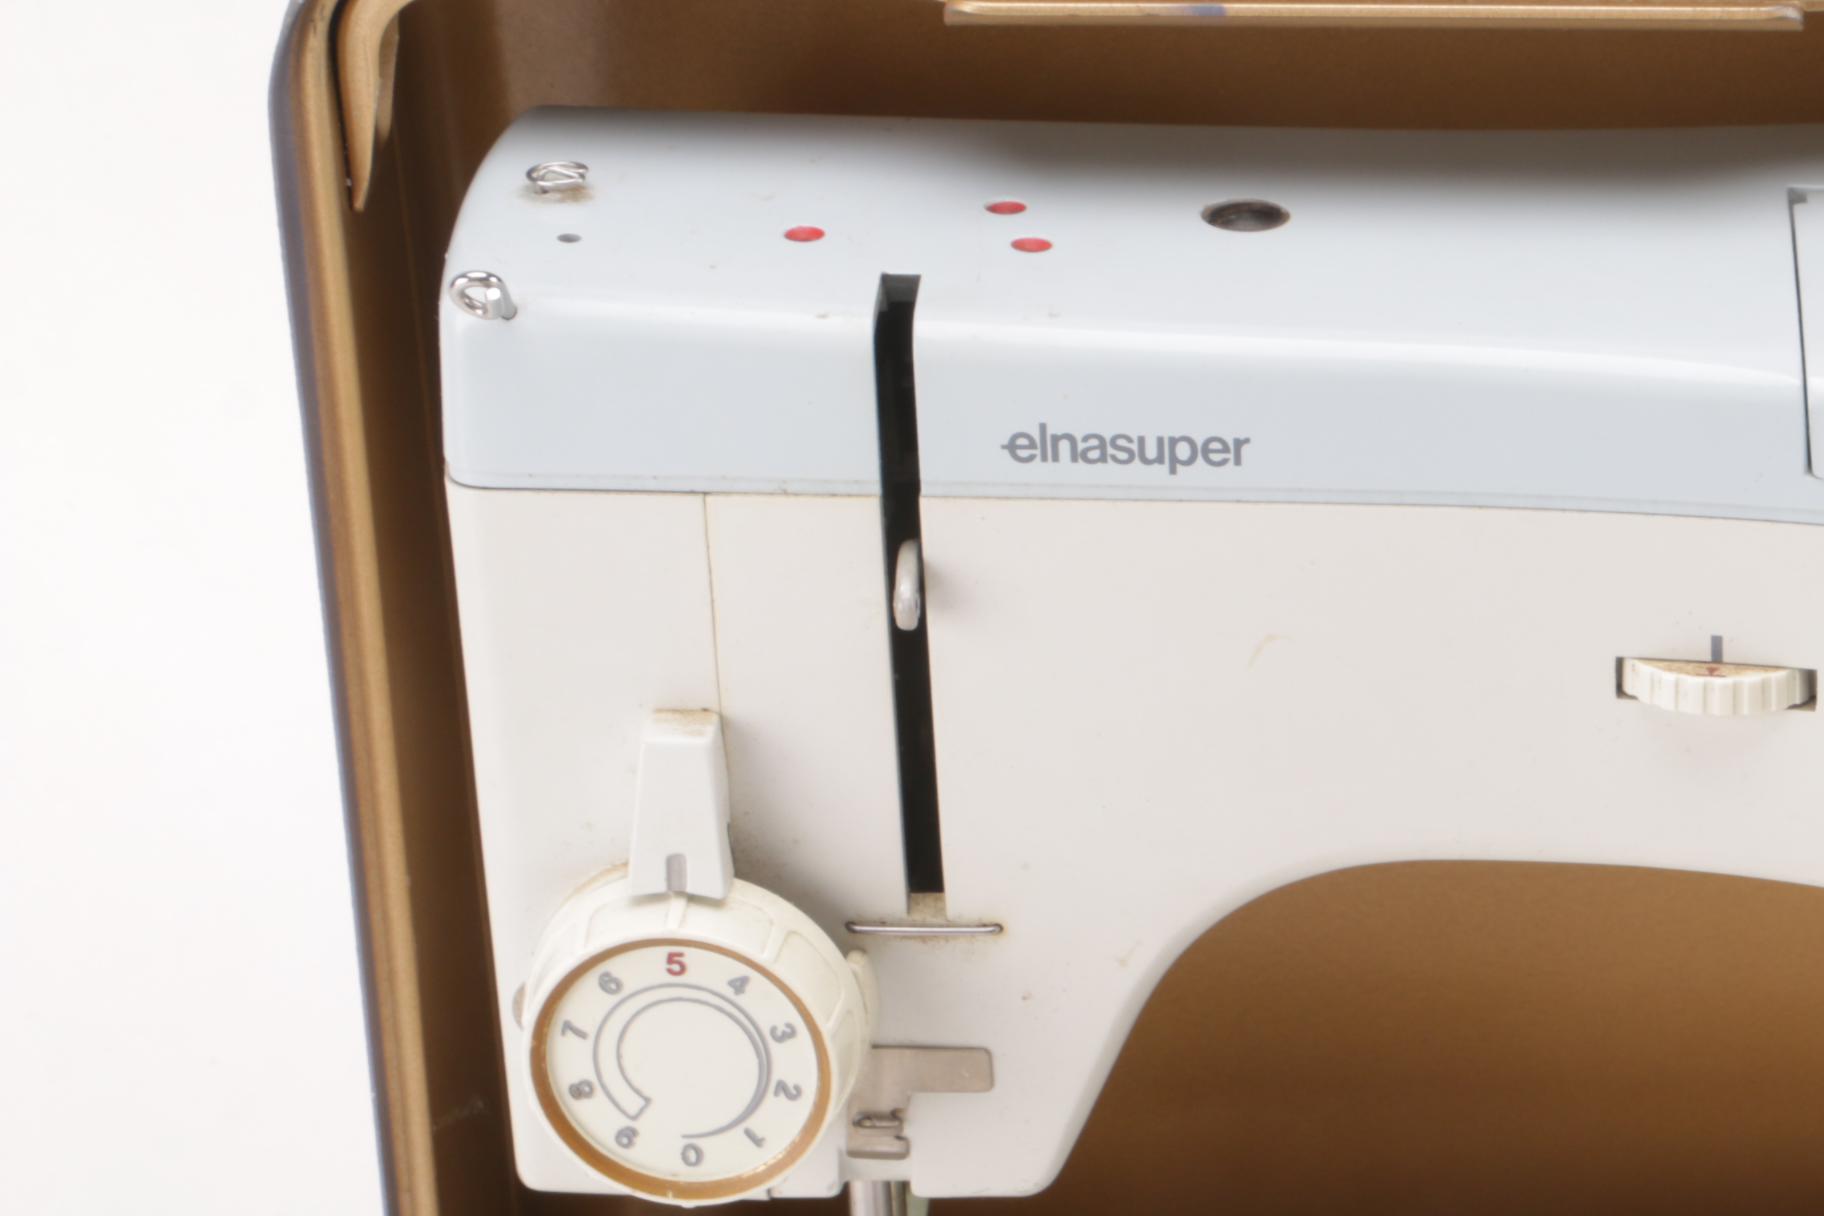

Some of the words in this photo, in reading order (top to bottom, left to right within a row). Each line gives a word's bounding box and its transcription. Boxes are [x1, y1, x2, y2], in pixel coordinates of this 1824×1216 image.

[1000, 422, 1251, 476] elnasuper
[666, 952, 687, 976] 5
[598, 971, 623, 995] 6
[728, 976, 750, 995] 4
[561, 1020, 588, 1040] 7
[770, 1023, 797, 1043] 3
[568, 1080, 594, 1100] 8
[774, 1080, 802, 1101] 2
[744, 1128, 765, 1148] 1
[681, 1143, 704, 1167] 0
